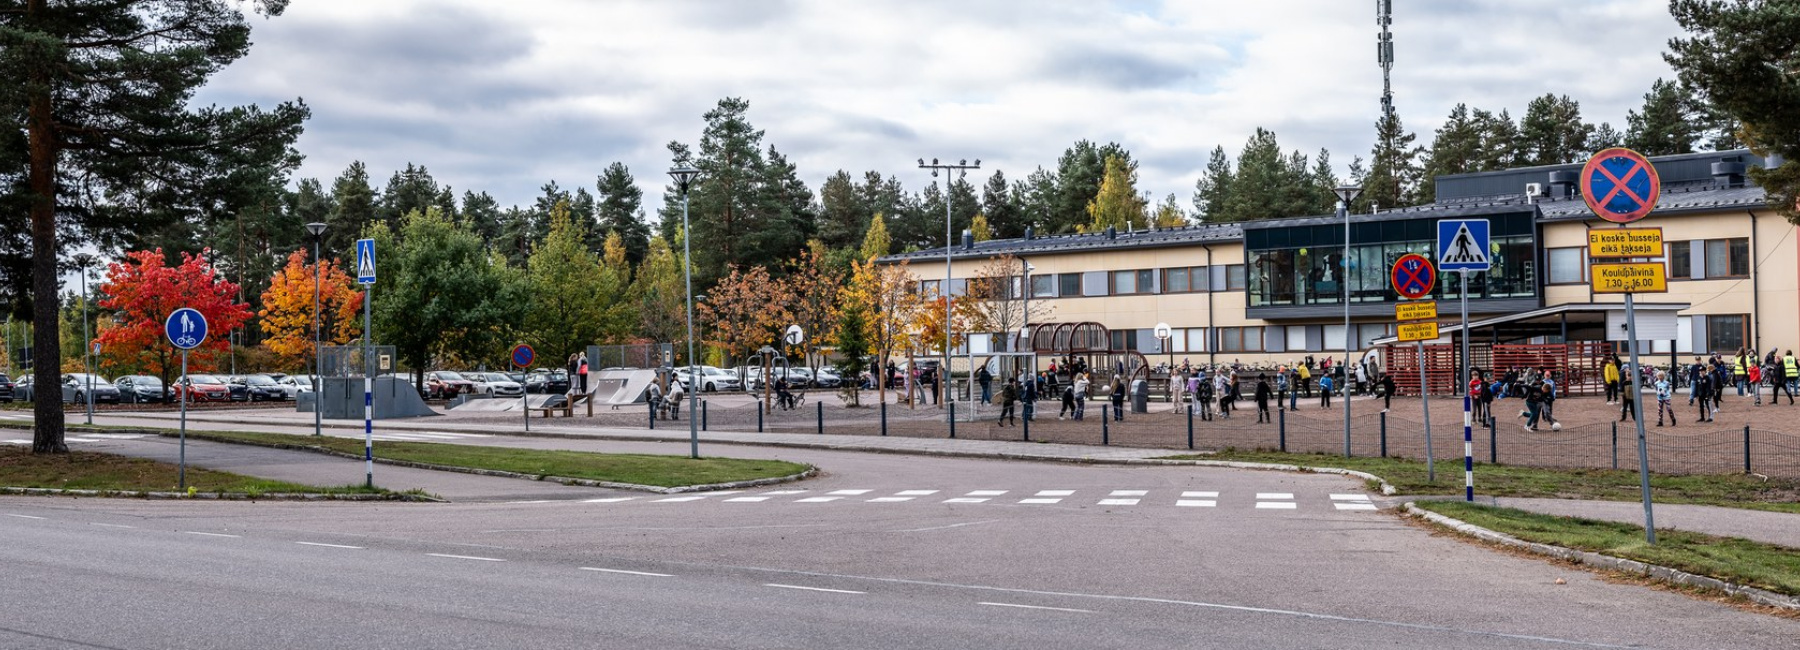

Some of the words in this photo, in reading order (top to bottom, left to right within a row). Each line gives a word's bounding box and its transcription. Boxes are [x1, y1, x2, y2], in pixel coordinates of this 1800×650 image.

[1590, 234, 1598, 243] Ei
[1601, 234, 1625, 242] koske
[1629, 234, 1660, 243] busseja
[1601, 245, 1617, 253] eikä
[1621, 244, 1651, 253] takseja
[1602, 268, 1654, 278] Koulupäivinä
[1605, 279, 1622, 287] 7.30
[1632, 278, 1653, 287] 16.00
